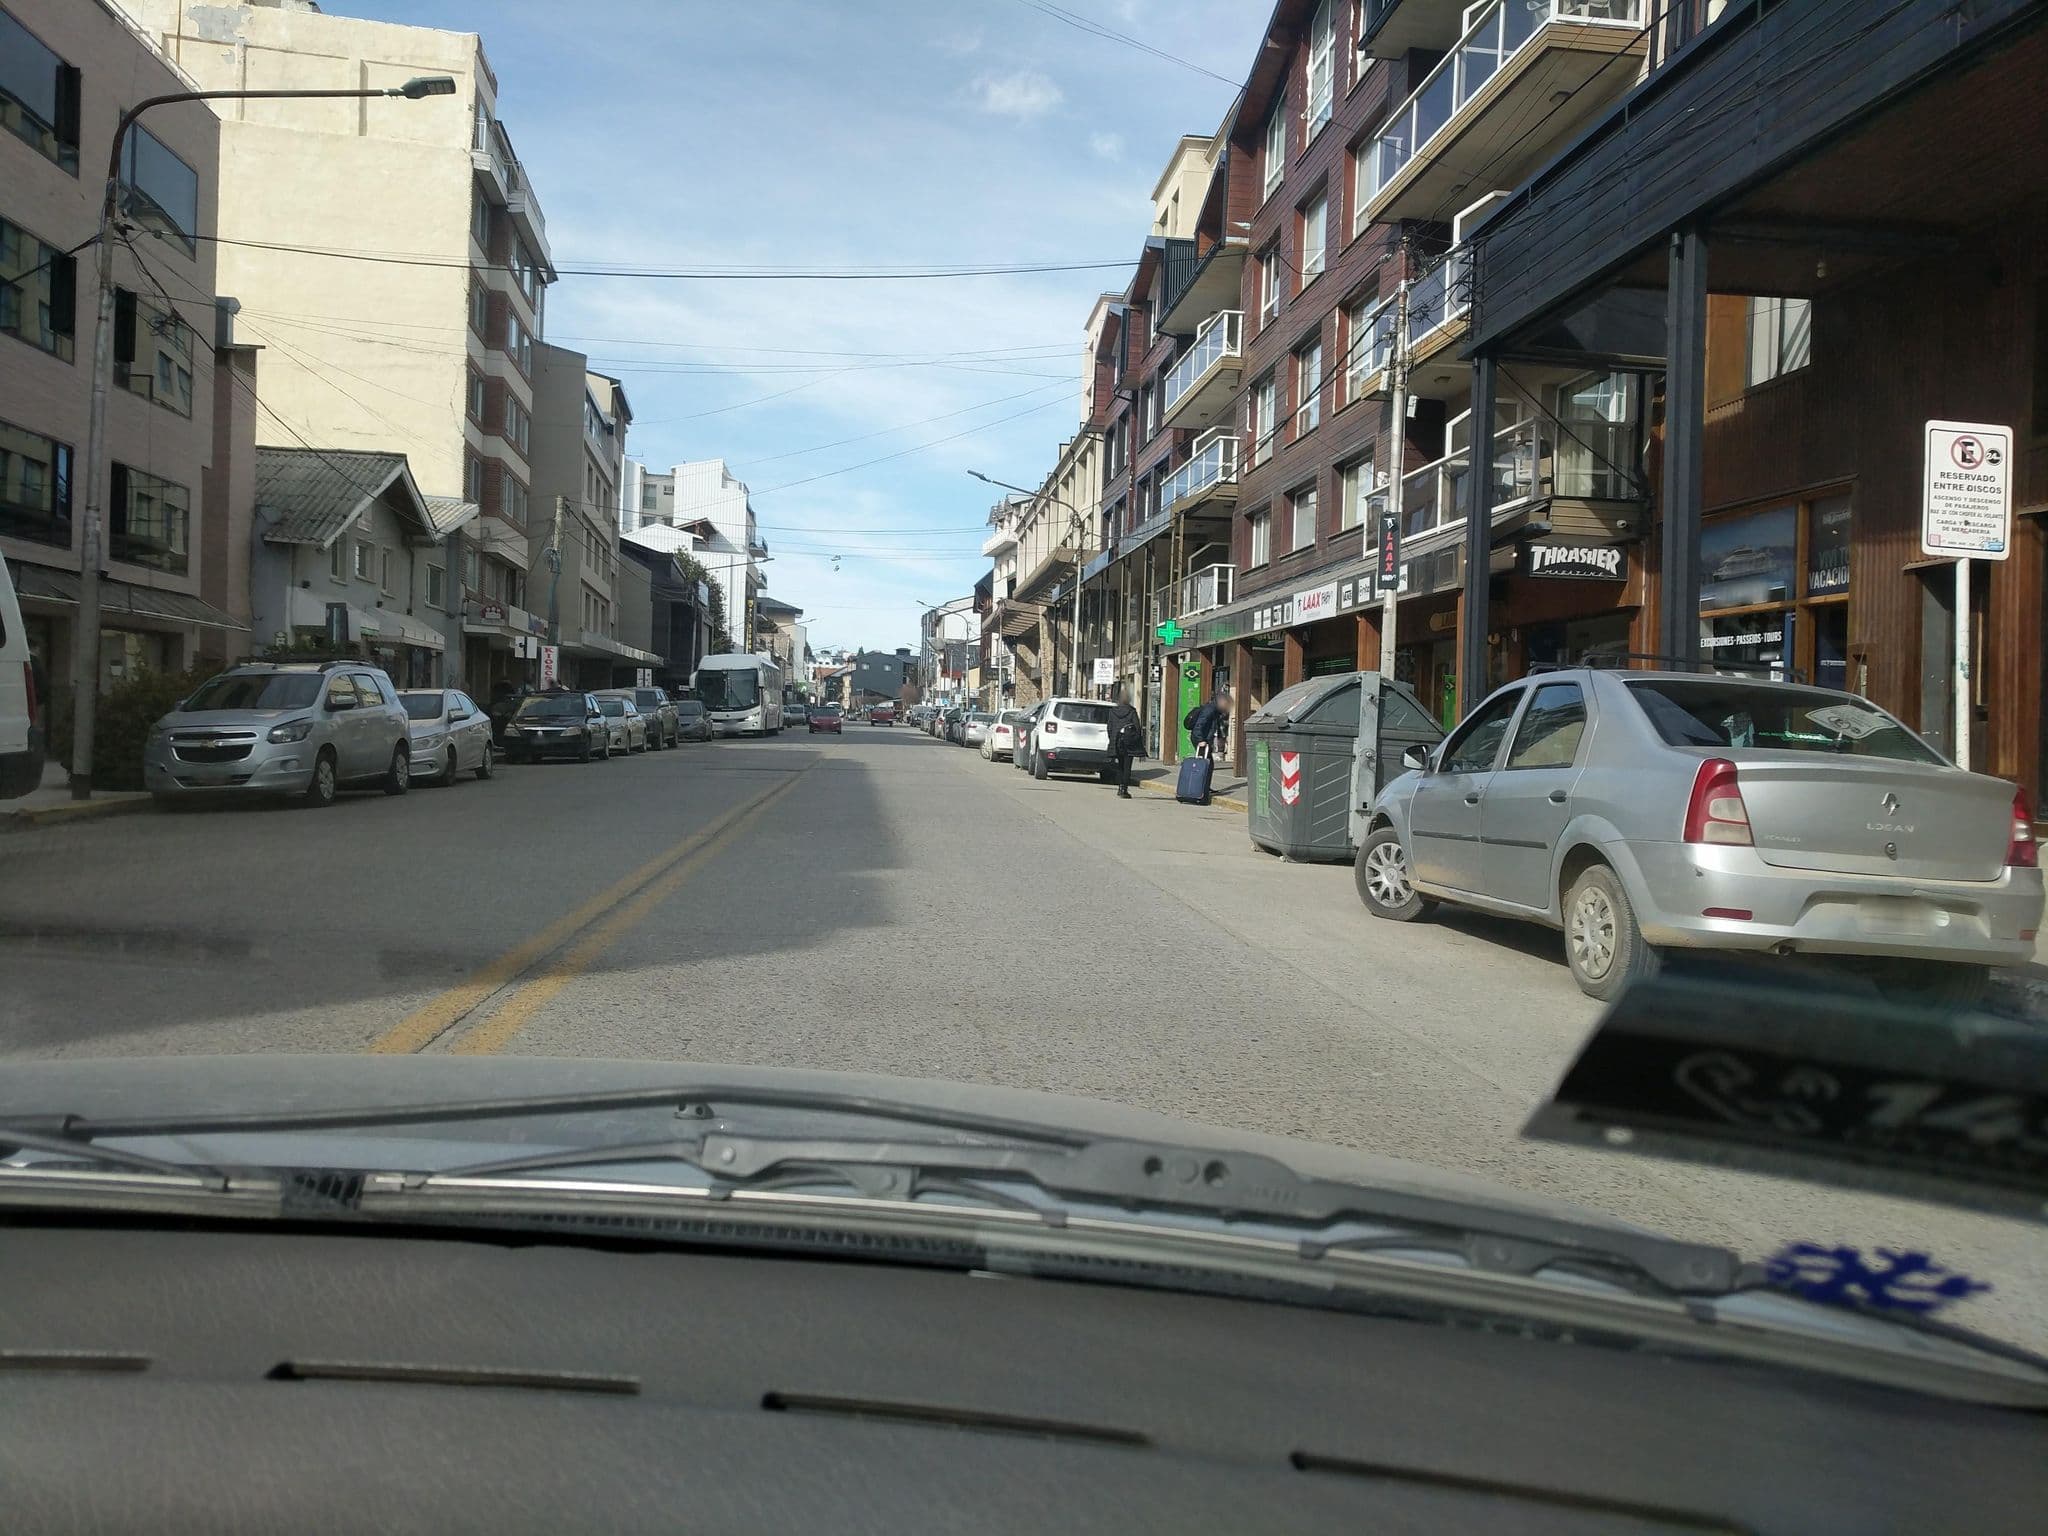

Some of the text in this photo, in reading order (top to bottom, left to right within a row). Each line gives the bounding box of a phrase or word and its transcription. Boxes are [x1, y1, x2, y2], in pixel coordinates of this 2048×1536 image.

[1940, 471, 1996, 483] RESERVADO
[1933, 482, 2002, 495] ENTRE DISCOS
[1933, 494, 1962, 502] ASCENSO
[1968, 497, 2002, 505] DESCENSO
[1954, 503, 1989, 511] PASAJEROS
[1951, 527, 1990, 535] MERCADERIA
[1385, 531, 1394, 572] LAAX
[1530, 545, 1621, 576] THRASHER
[1302, 592, 1321, 612] LAAX
[1866, 822, 1915, 833] LOGAN
